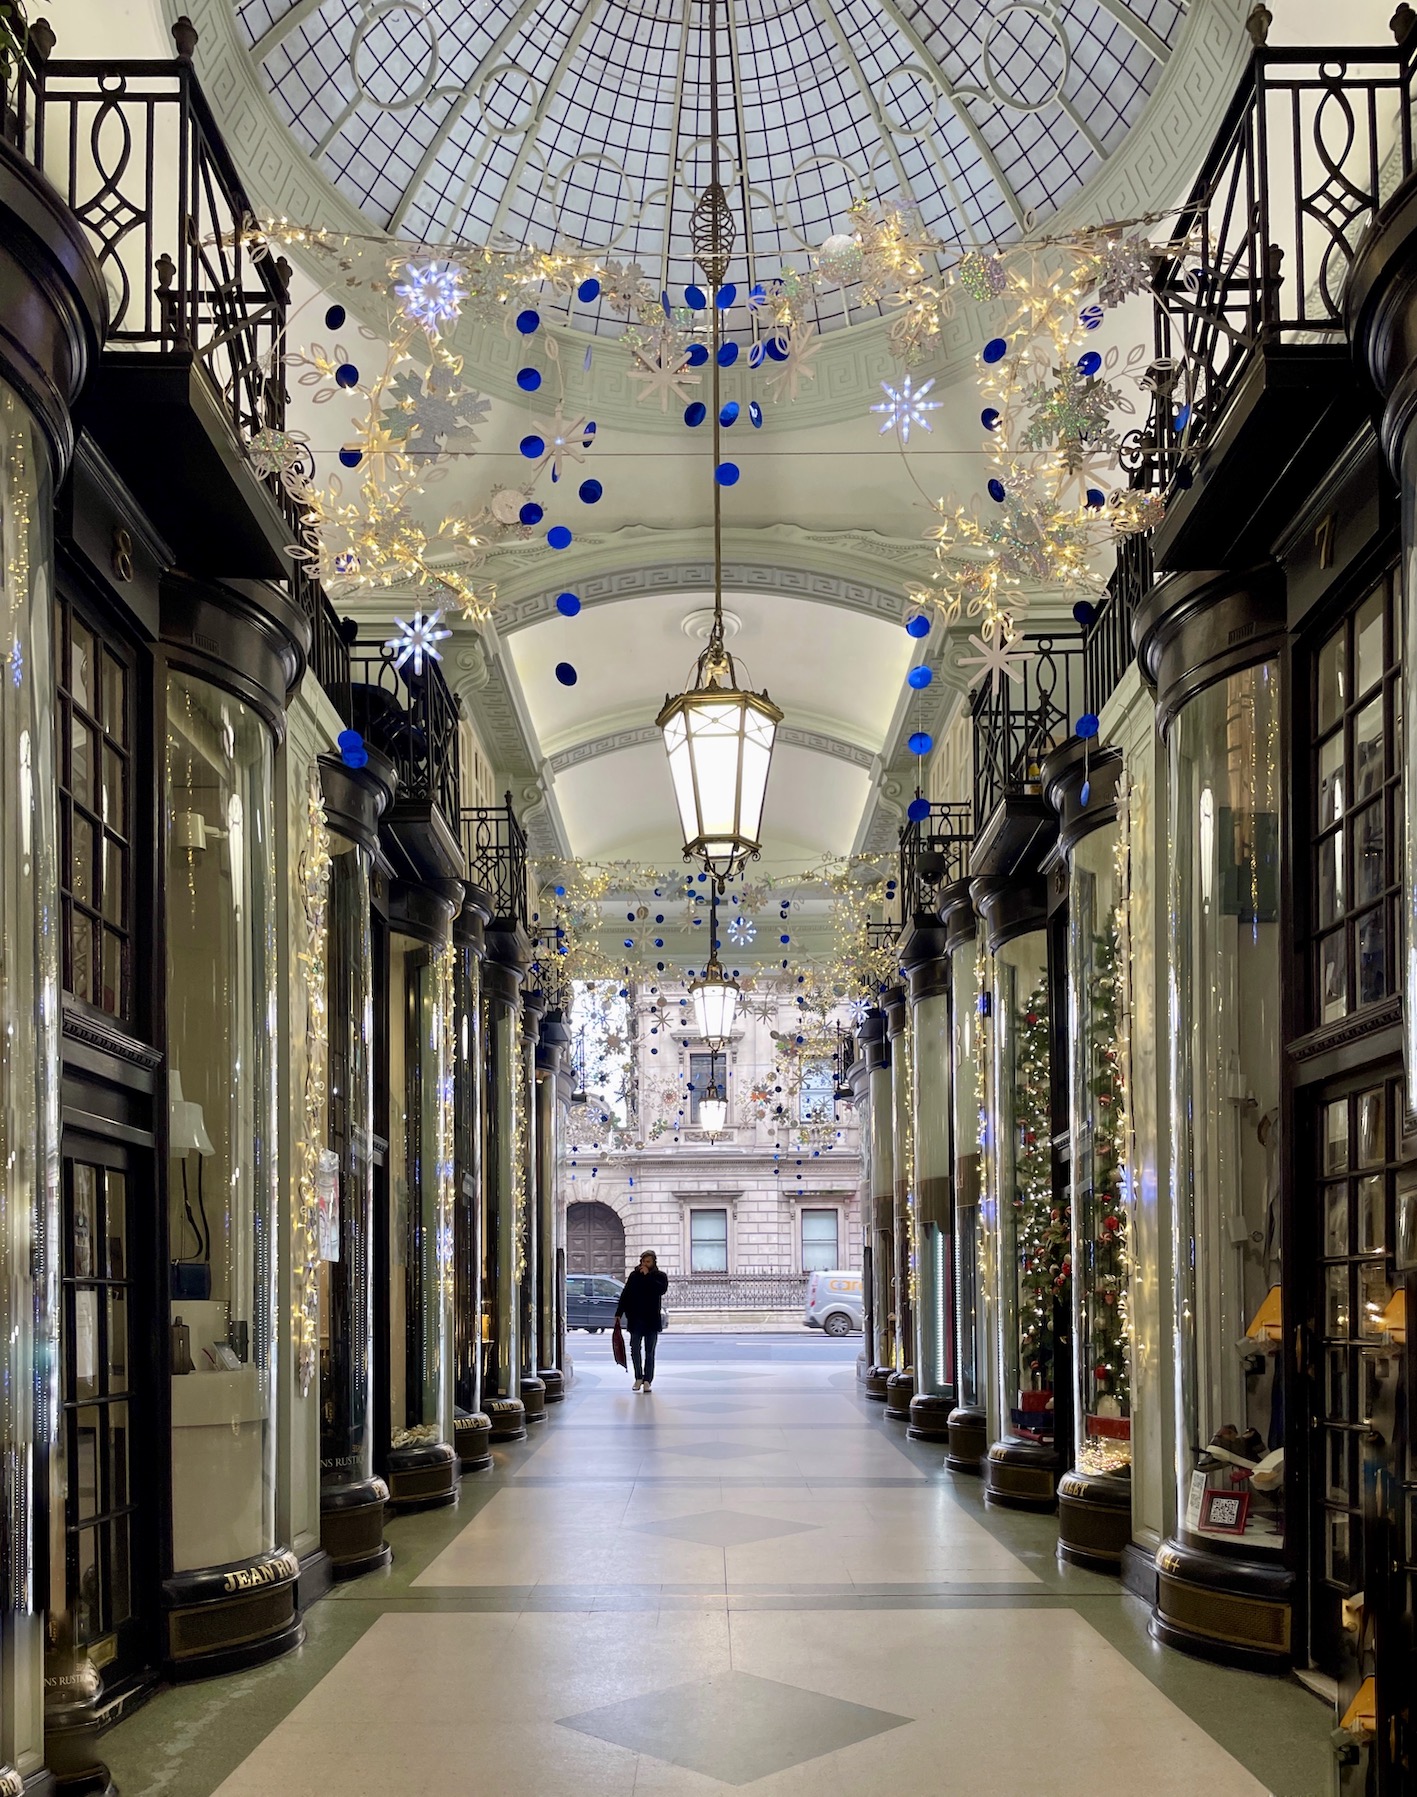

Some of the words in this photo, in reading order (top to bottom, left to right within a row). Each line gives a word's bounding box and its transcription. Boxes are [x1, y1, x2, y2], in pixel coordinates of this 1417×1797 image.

[117, 530, 134, 583] 8
[1314, 514, 1330, 570] 7
[223, 1563, 276, 1593] JEAN
